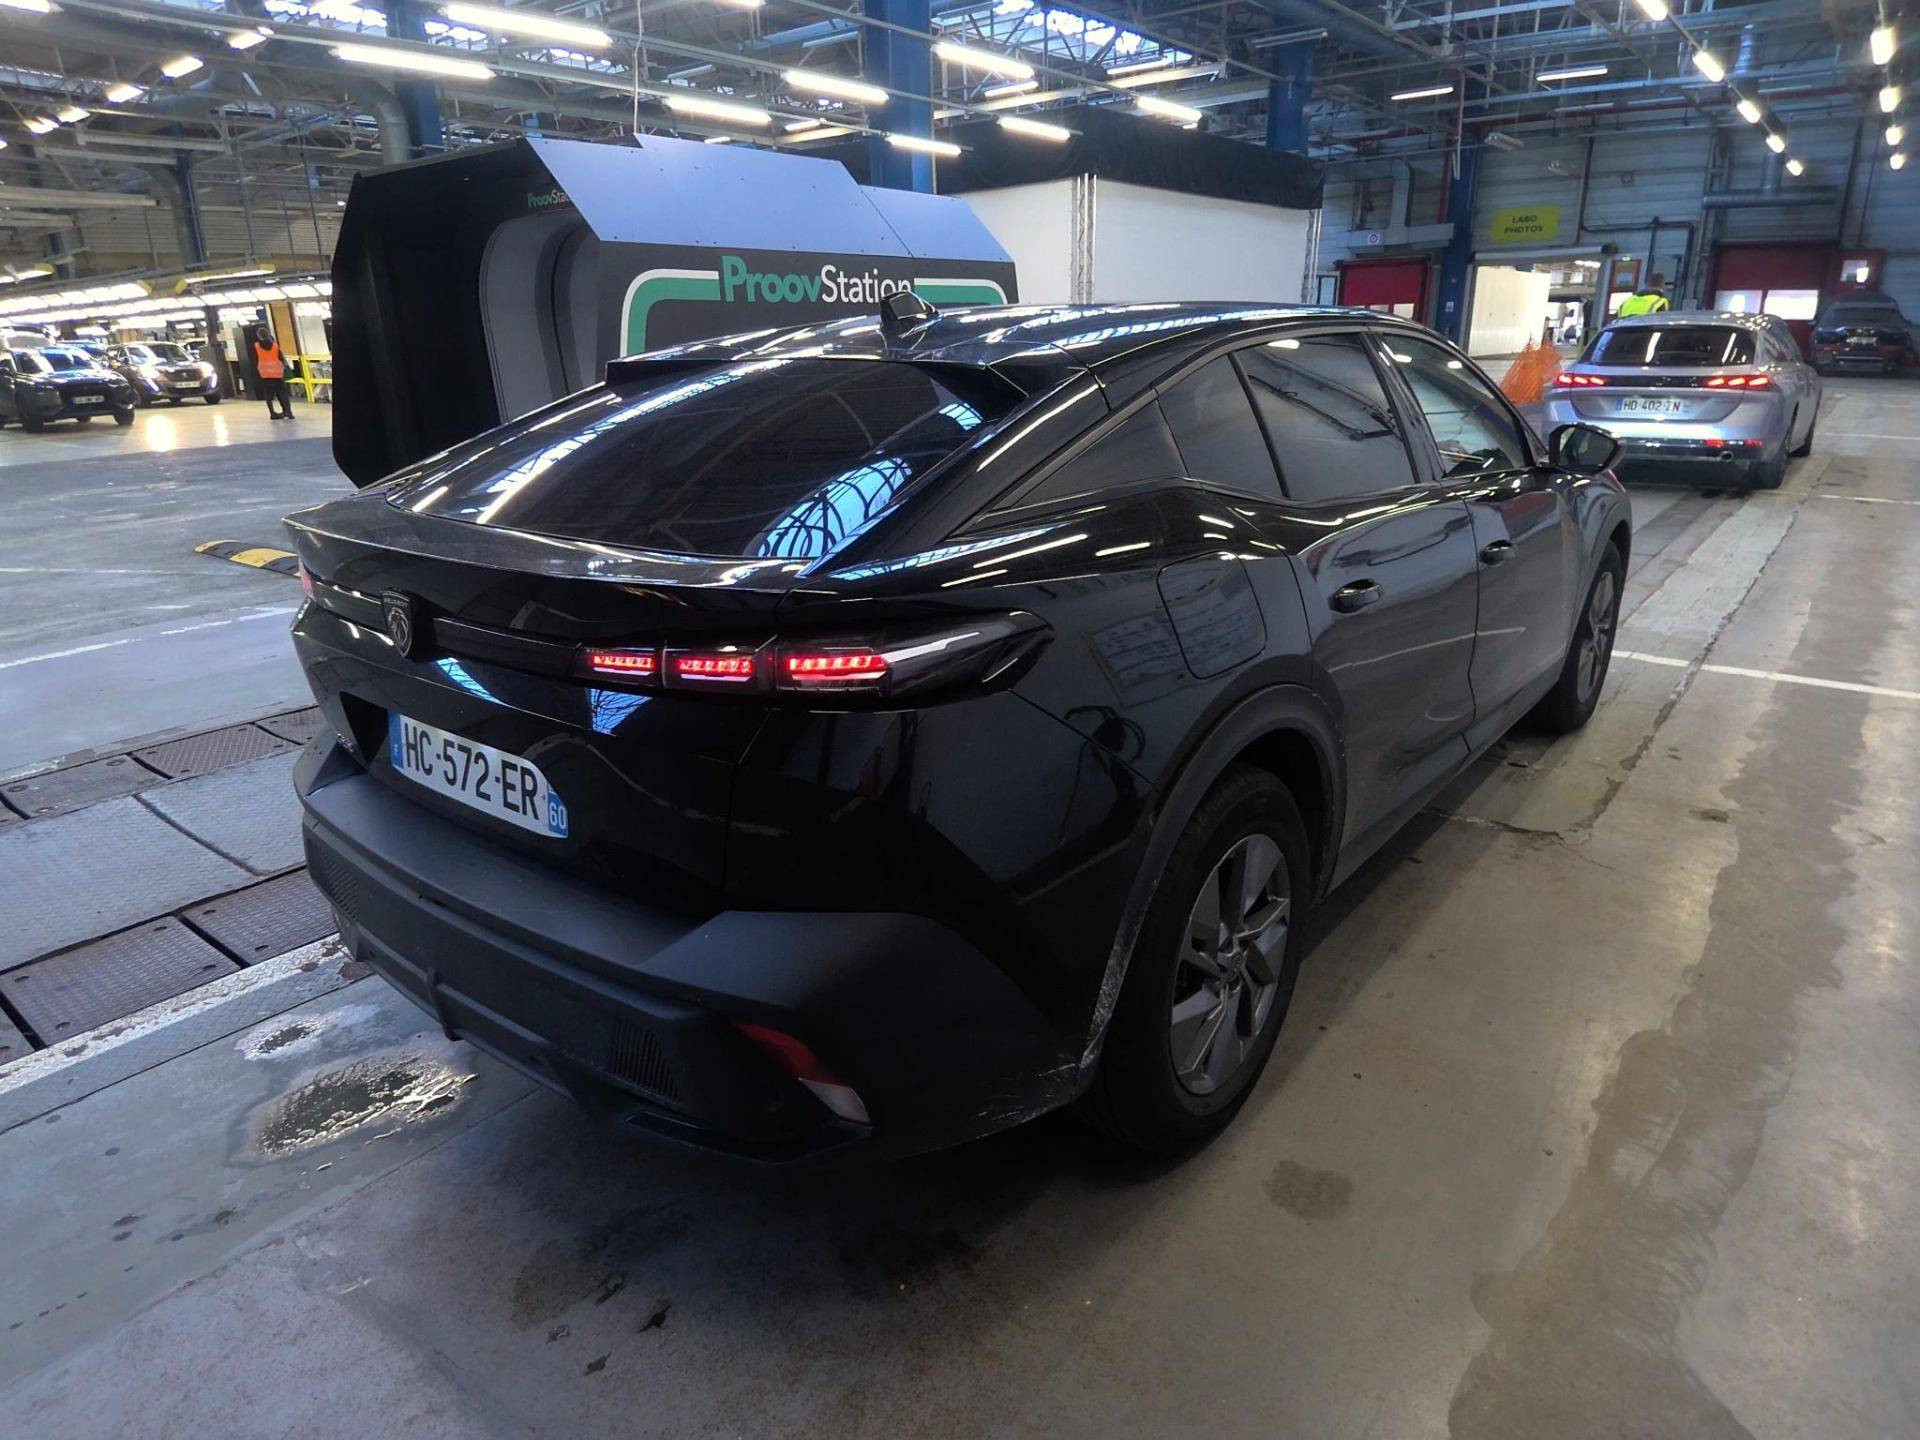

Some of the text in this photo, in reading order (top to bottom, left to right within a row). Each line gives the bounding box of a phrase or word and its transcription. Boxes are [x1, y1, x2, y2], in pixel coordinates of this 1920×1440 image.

[1511, 214, 1538, 225] LABO
[1504, 225, 1544, 235] PHOTOS
[404, 722, 540, 821] HC-572-ER
[549, 802, 567, 830] 60
